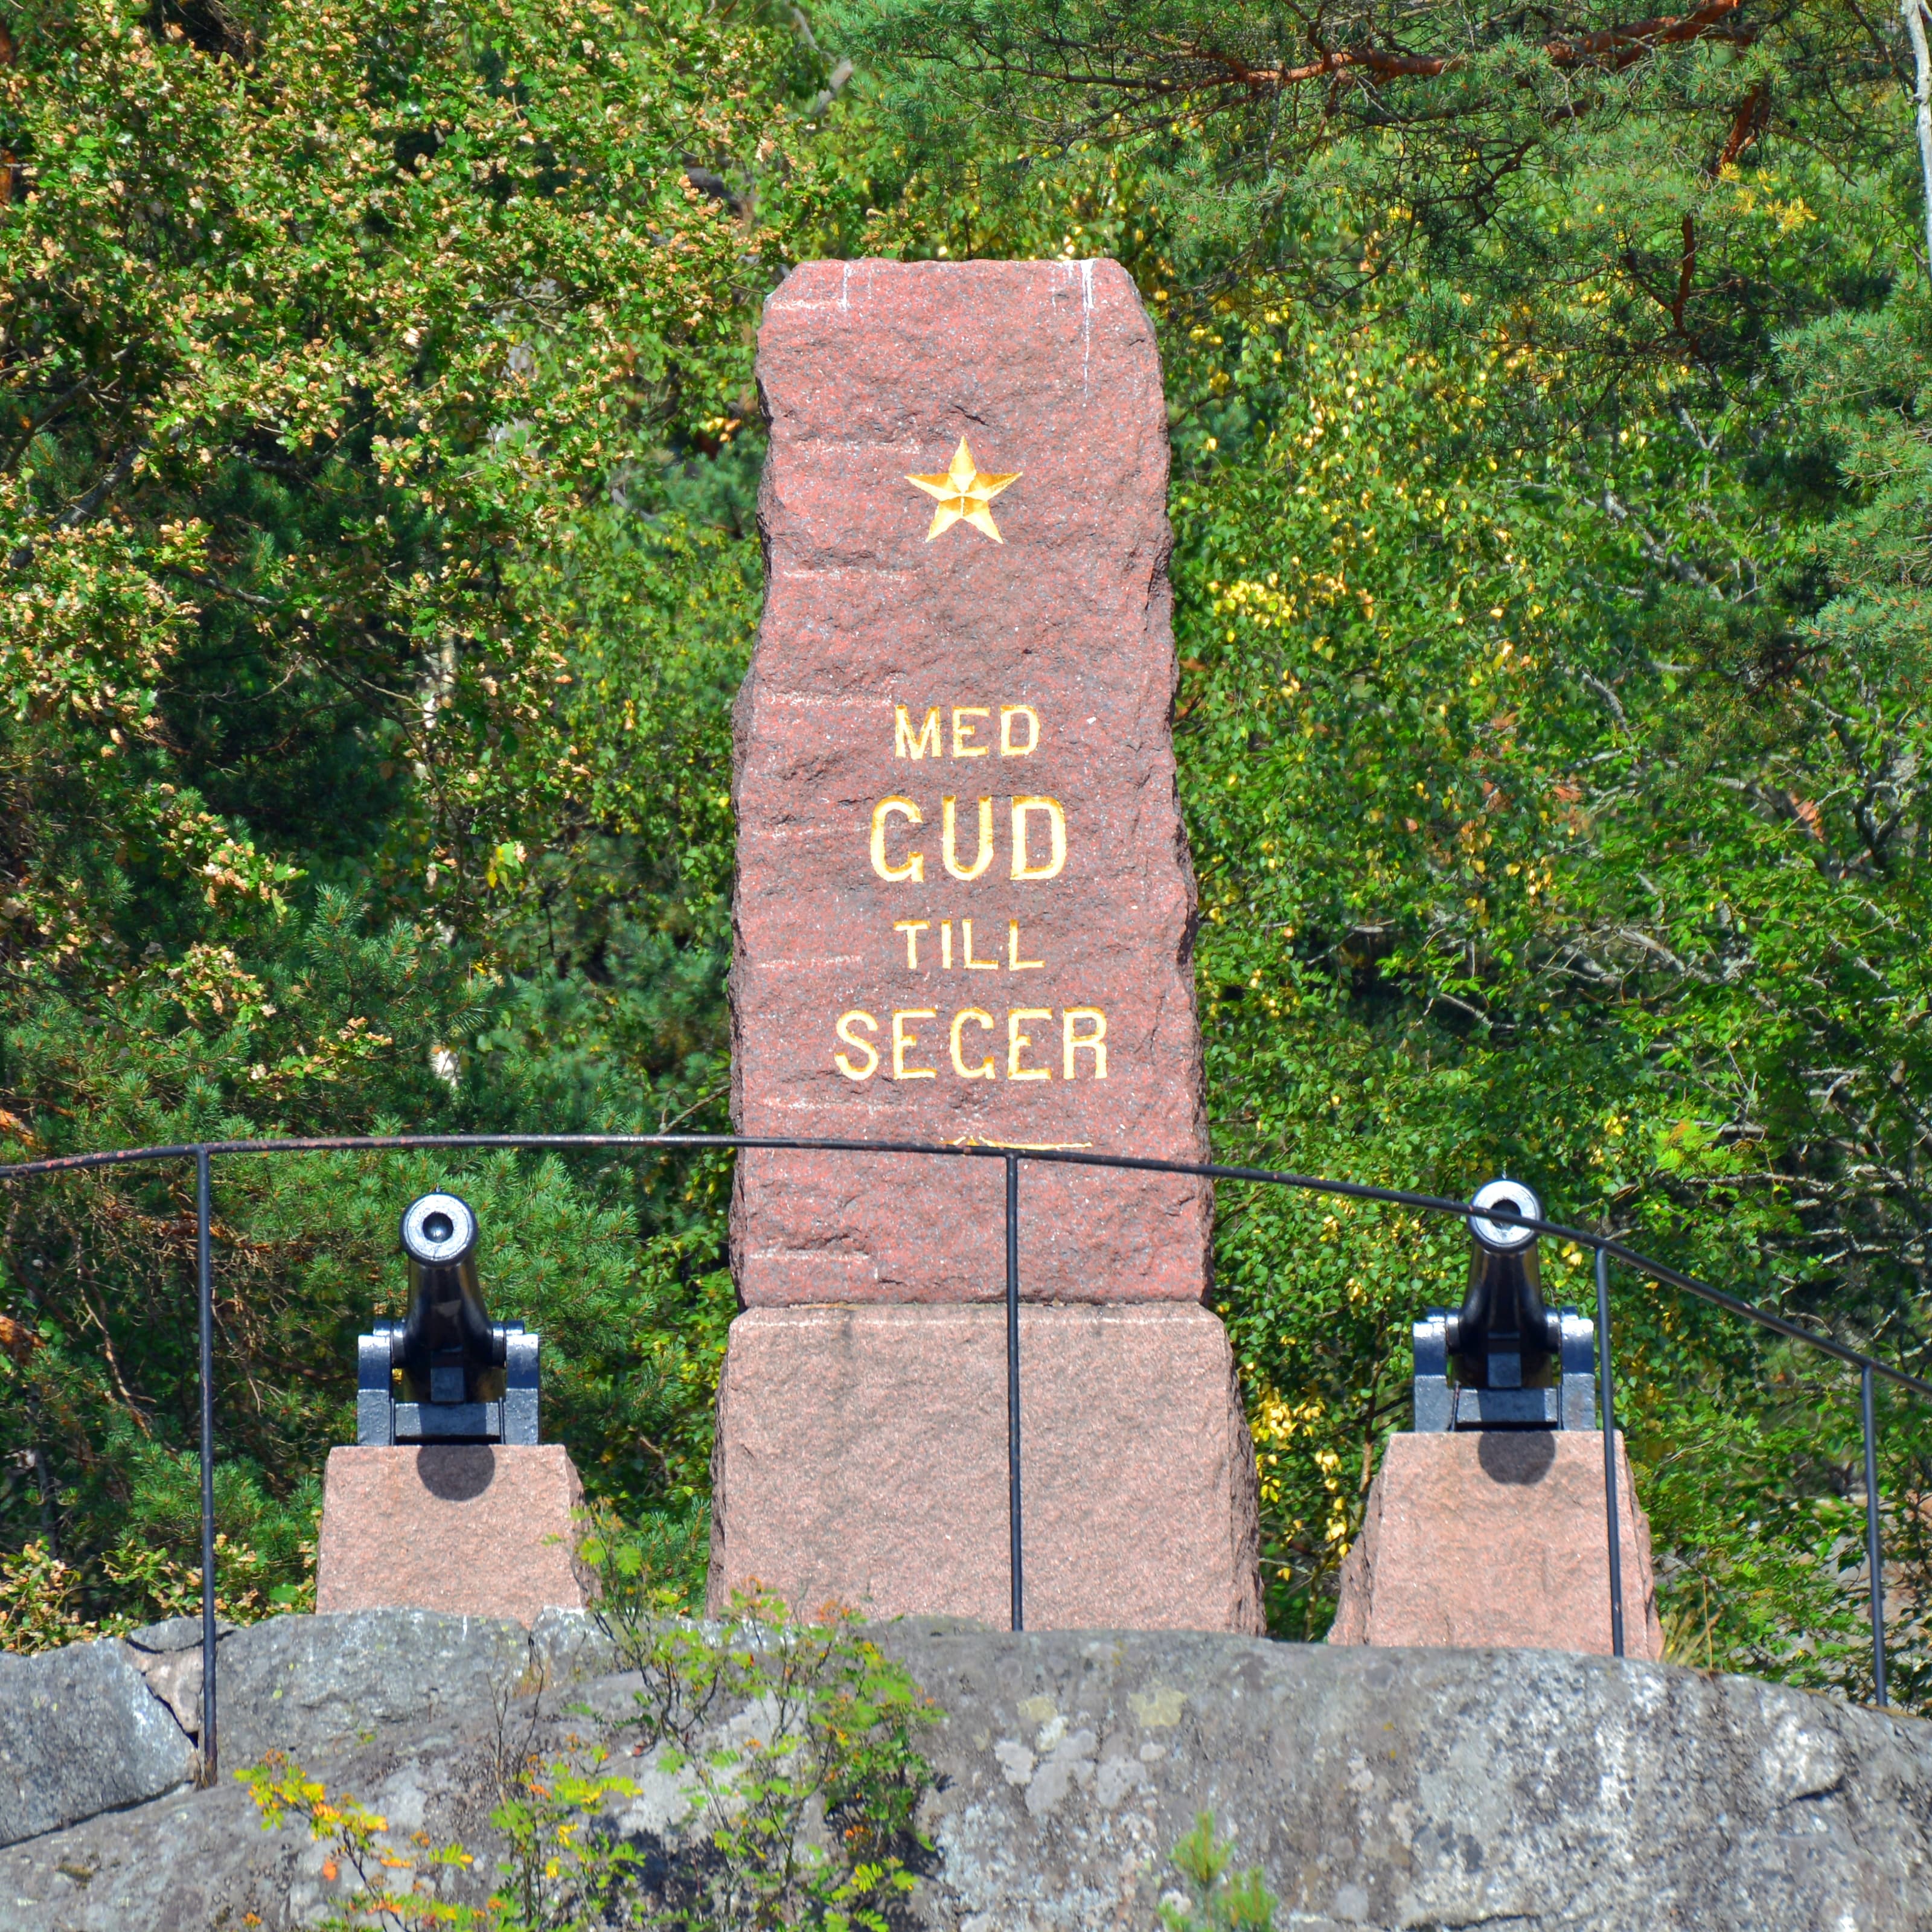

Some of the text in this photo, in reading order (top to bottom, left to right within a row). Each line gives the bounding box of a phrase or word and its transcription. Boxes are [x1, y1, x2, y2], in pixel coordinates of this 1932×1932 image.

[894, 704, 1041, 760] MED
[870, 795, 1067, 883] GUD
[894, 918, 1046, 970] TILL
[834, 1006, 1108, 1081] SEGER
